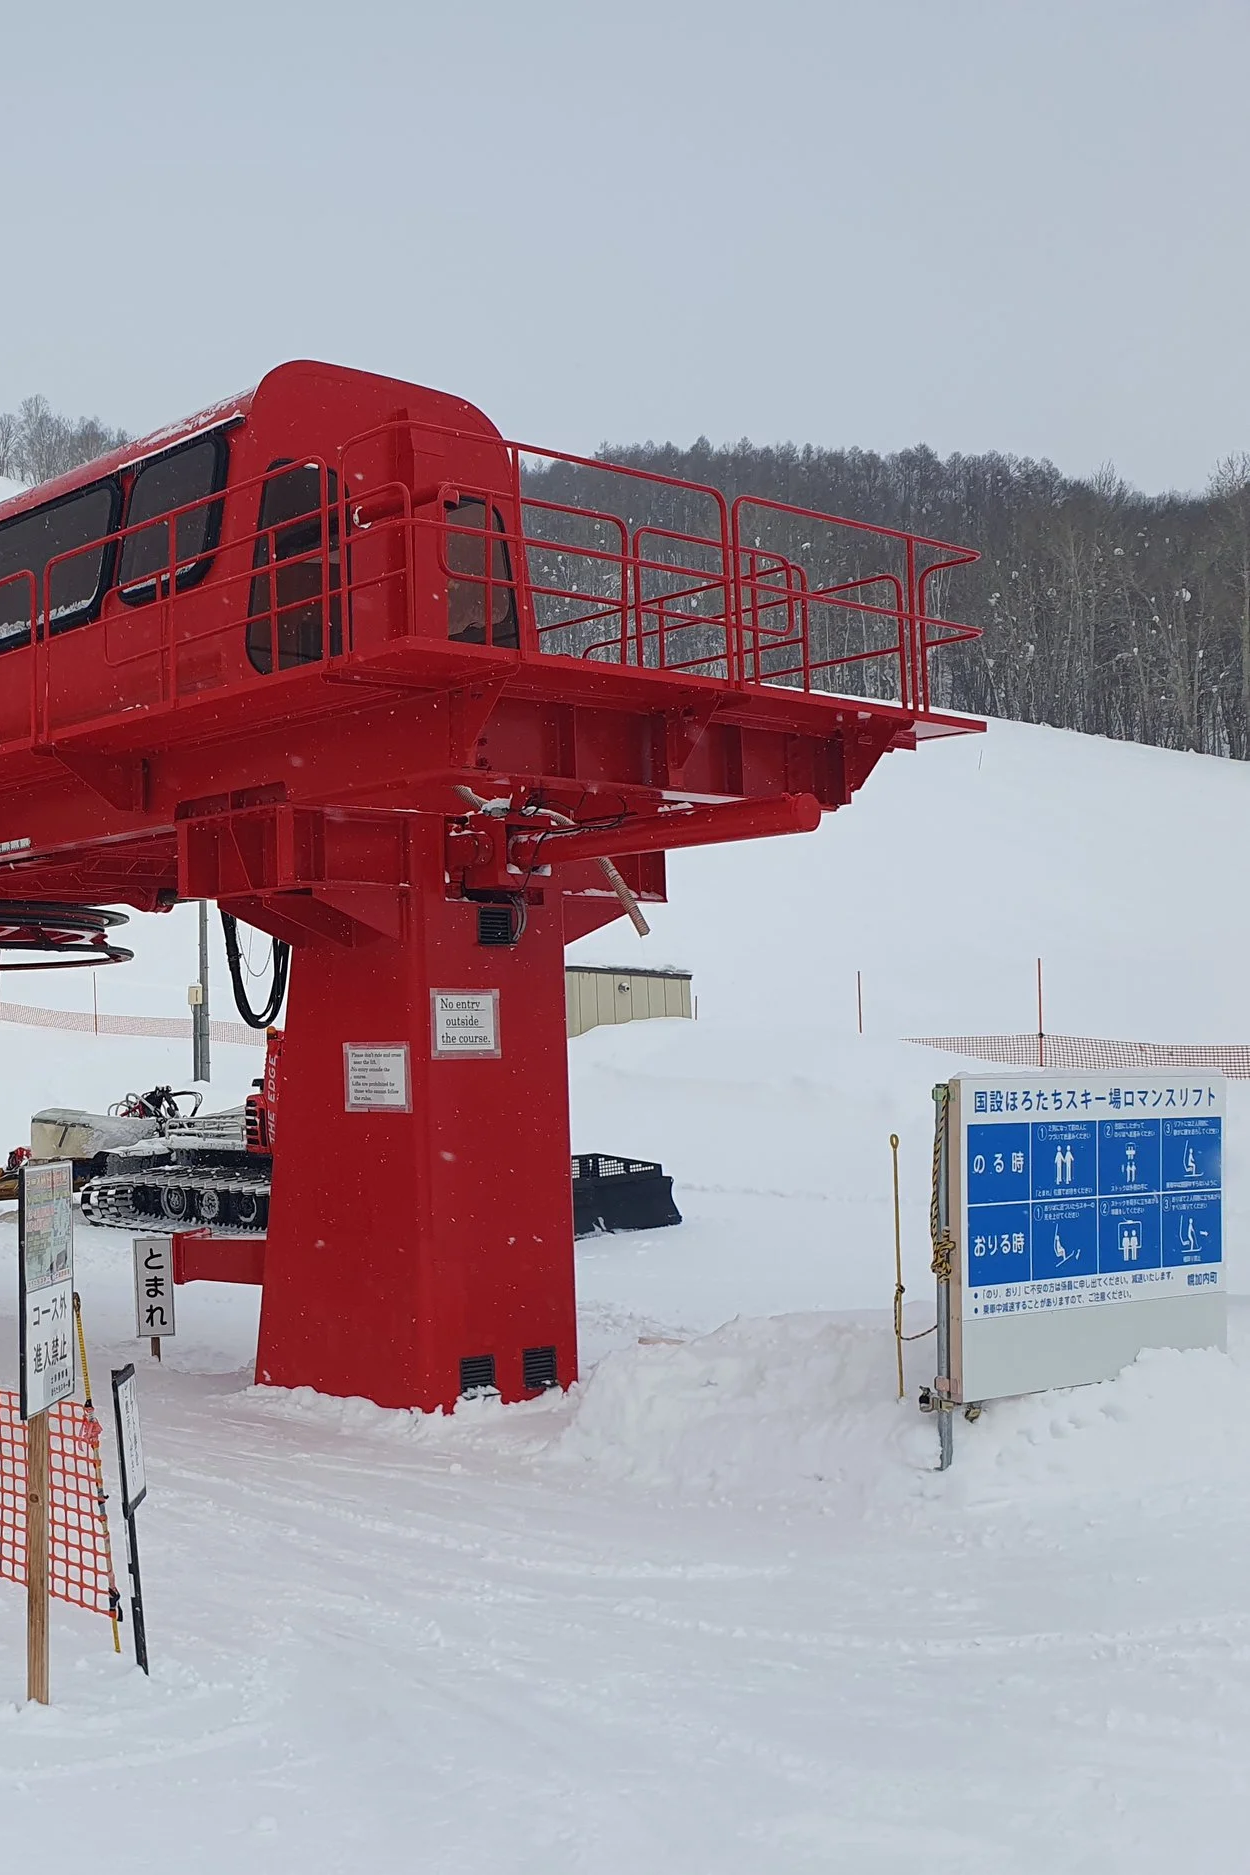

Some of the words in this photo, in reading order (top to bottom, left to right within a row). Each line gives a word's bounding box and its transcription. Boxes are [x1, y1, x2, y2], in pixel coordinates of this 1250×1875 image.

[440, 998, 454, 1009] No
[456, 1000, 481, 1011] entry
[446, 1015, 479, 1026] outside
[441, 1032, 457, 1044] the
[458, 1035, 491, 1044] course.
[268, 1054, 277, 1103] EDGE
[974, 1087, 1216, 1113] 国設ほろたちスキー場ロマンスリフト
[268, 1111, 276, 1143] THE
[973, 1151, 1025, 1174] のる時
[973, 1232, 1025, 1257] おりる時
[144, 1247, 167, 1328] とまれ
[33, 1290, 67, 1326] コース外
[33, 1332, 68, 1374] 進入禁止
